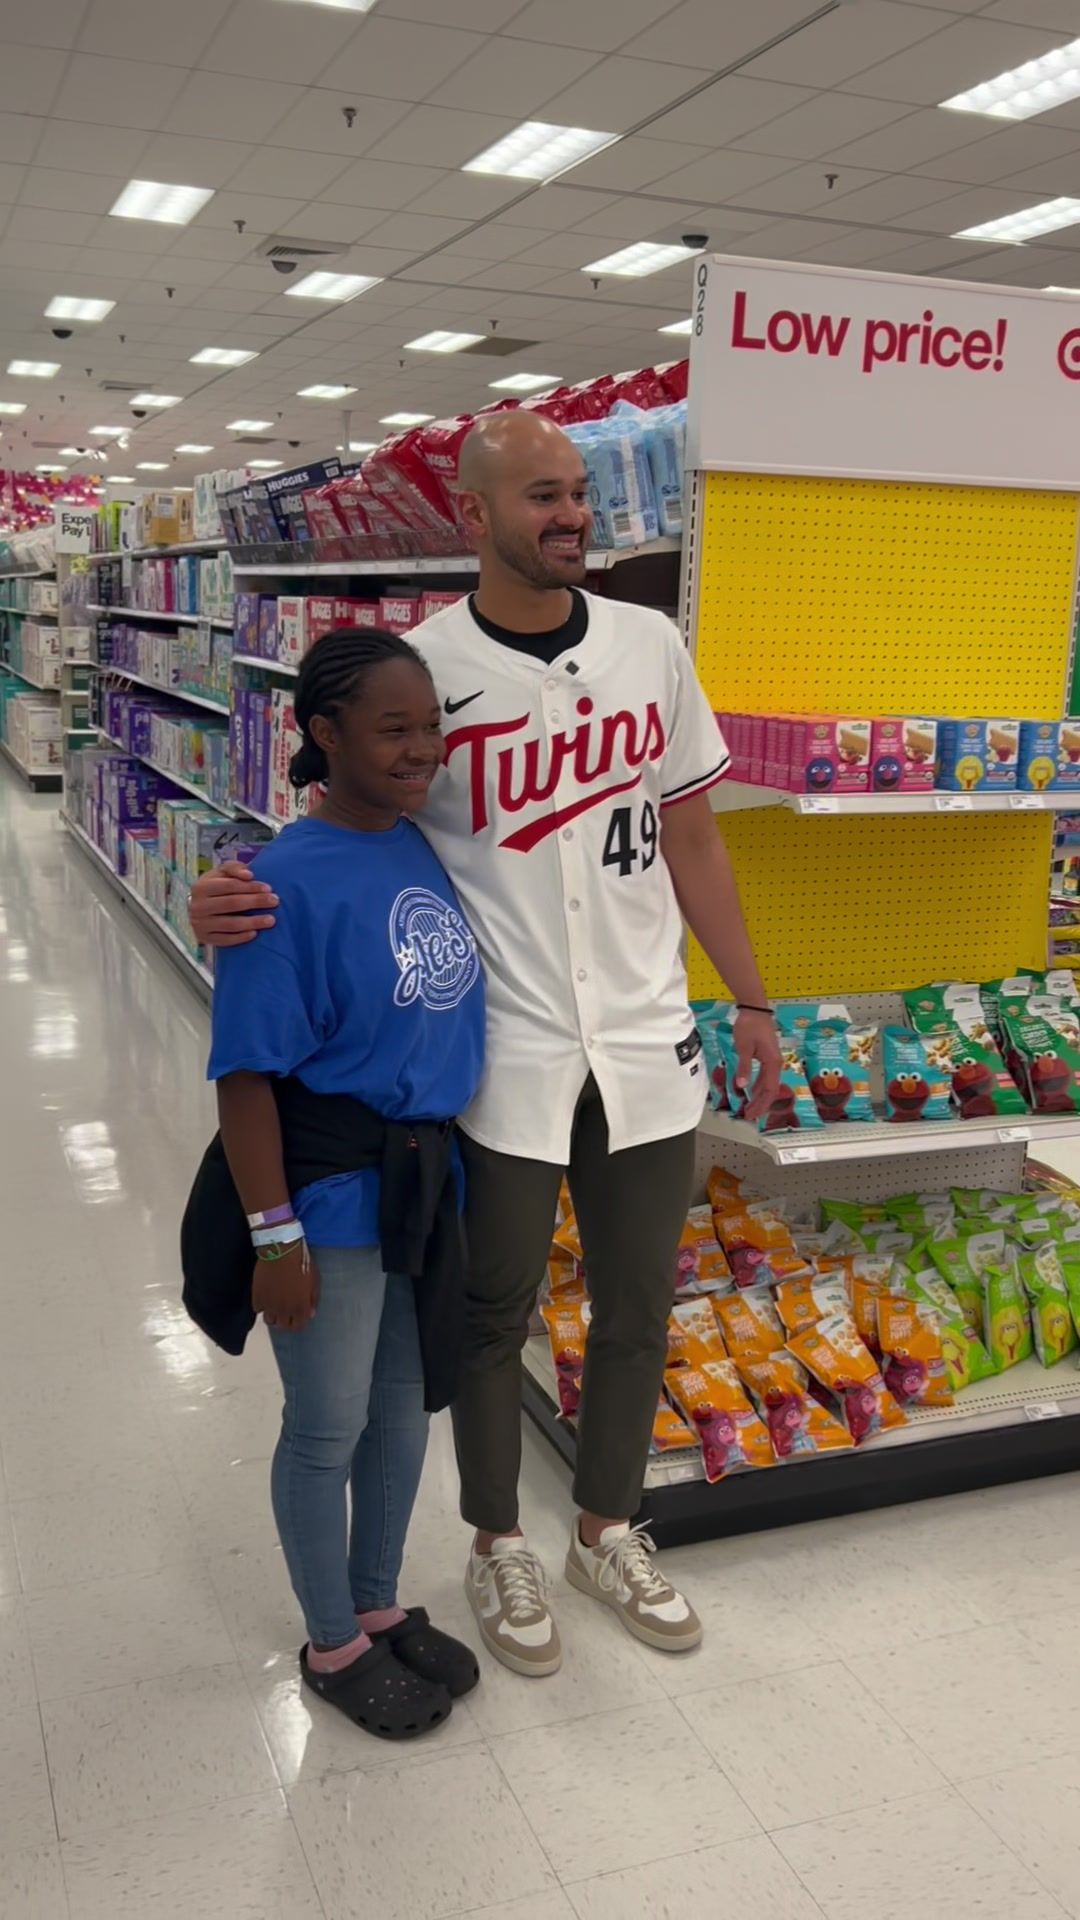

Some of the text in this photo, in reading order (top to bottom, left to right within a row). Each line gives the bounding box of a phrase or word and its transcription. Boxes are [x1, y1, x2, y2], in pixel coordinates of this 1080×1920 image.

[695, 263, 708, 337] Q28
[731, 291, 1007, 373] Low price!
[267, 471, 310, 493] HUGGIES
[61, 512, 92, 527] Expe
[61, 524, 84, 538] Pay
[441, 696, 666, 836] Twins
[602, 799, 658, 877] 49
